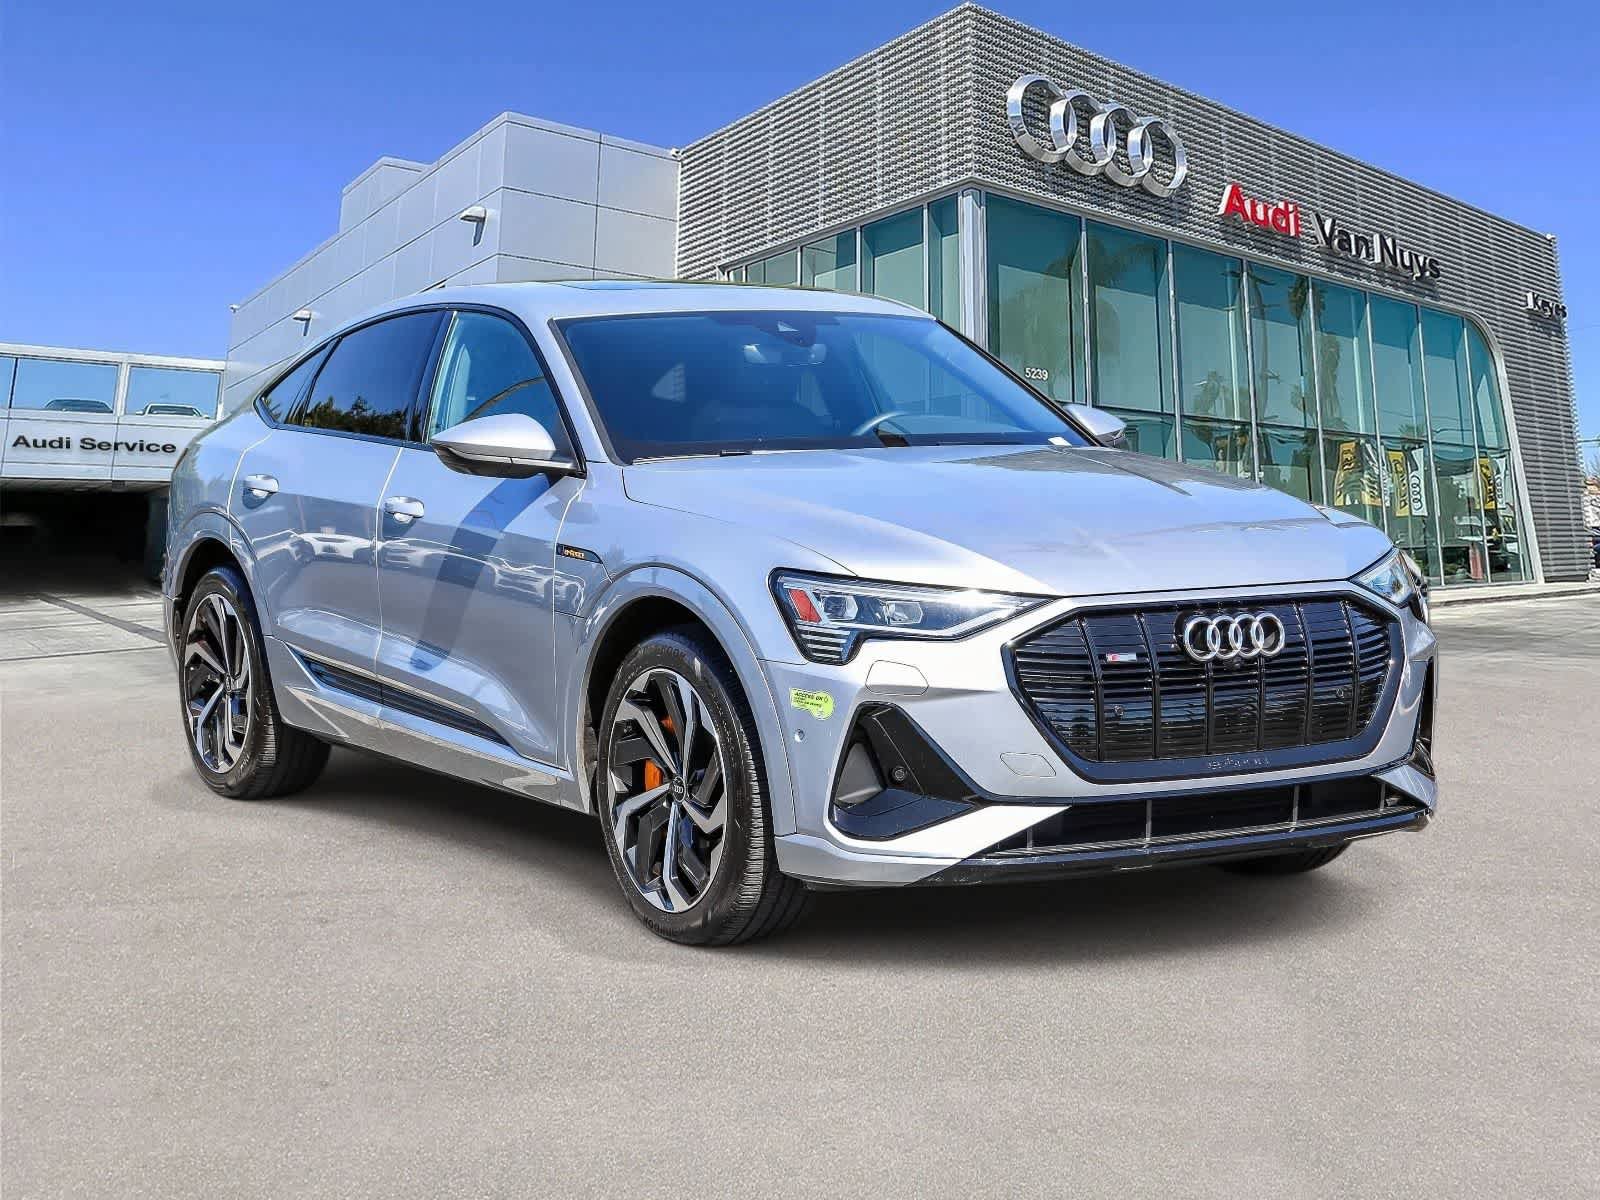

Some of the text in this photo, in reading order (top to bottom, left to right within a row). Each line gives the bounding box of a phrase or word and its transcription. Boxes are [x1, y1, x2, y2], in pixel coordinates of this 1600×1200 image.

[1218, 182, 1441, 280] Audi Van Nuys
[1526, 292, 1568, 319] Keyes
[1024, 367, 1049, 381] 5239
[12, 435, 177, 453] Audi Service
